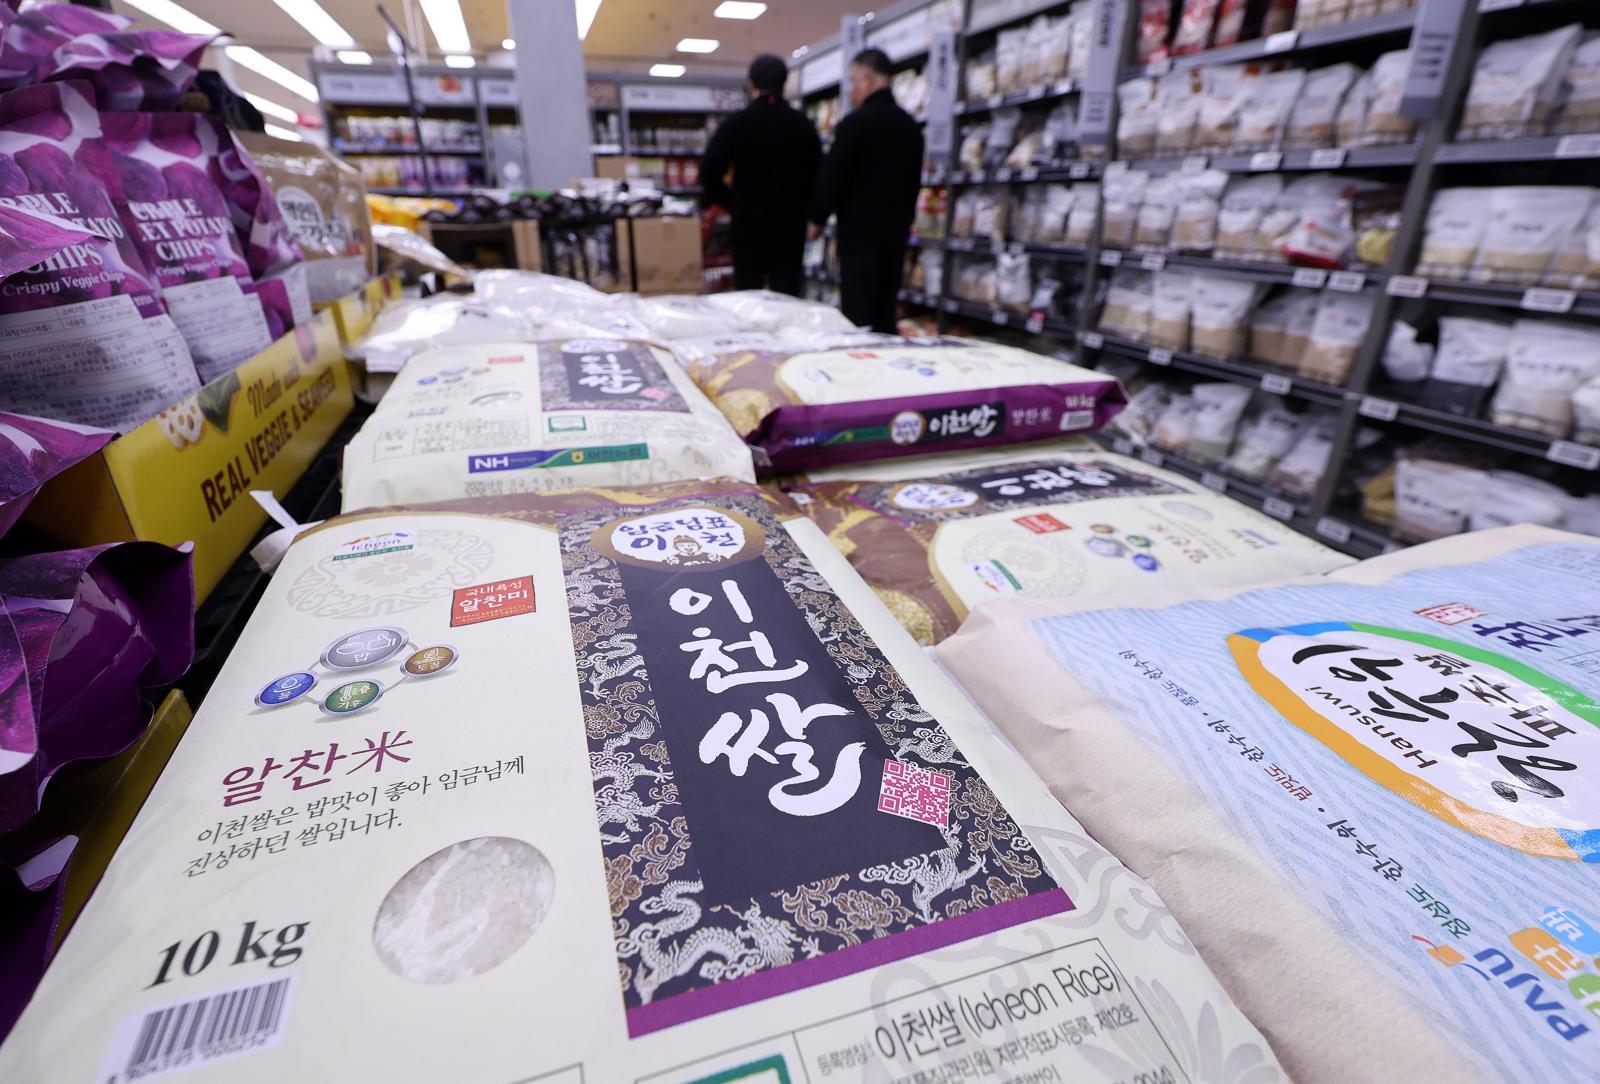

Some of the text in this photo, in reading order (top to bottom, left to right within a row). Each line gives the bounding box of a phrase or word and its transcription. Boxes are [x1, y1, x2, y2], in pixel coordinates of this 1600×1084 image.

[2, 279, 61, 297] Crispy
[61, 273, 100, 289] Veggie
[156, 238, 216, 261] CHIPS
[929, 403, 998, 438] 이천쌀
[200, 455, 251, 523] REAL
[245, 411, 293, 476] VEGGIE
[474, 456, 509, 470] NH
[459, 589, 529, 613] 알찬미
[669, 579, 867, 817] 이천쌀
[1292, 644, 1578, 803] 한수위
[1304, 685, 1439, 769] Hansuwi
[1413, 653, 1577, 740] 파주쌀
[196, 755, 525, 845] 이천쌀은 밥맛이 좋아 임금님께
[222, 730, 414, 807] 알찬米
[1118, 650, 1472, 939] 정성도 한수위 밥맛도 한수위 품질도 한수위
[182, 808, 403, 878] 진상하던 쌀입니다.
[142, 920, 312, 991] 10 kg
[1473, 947, 1590, 1042] PAJU
[875, 1001, 966, 1062] 이천쌀
[959, 981, 1059, 1040] (Icheon
[1052, 952, 1122, 1002] Rice)
[993, 1014, 1097, 1066] 지리적표시등록
[1094, 1002, 1139, 1031] 제12호
